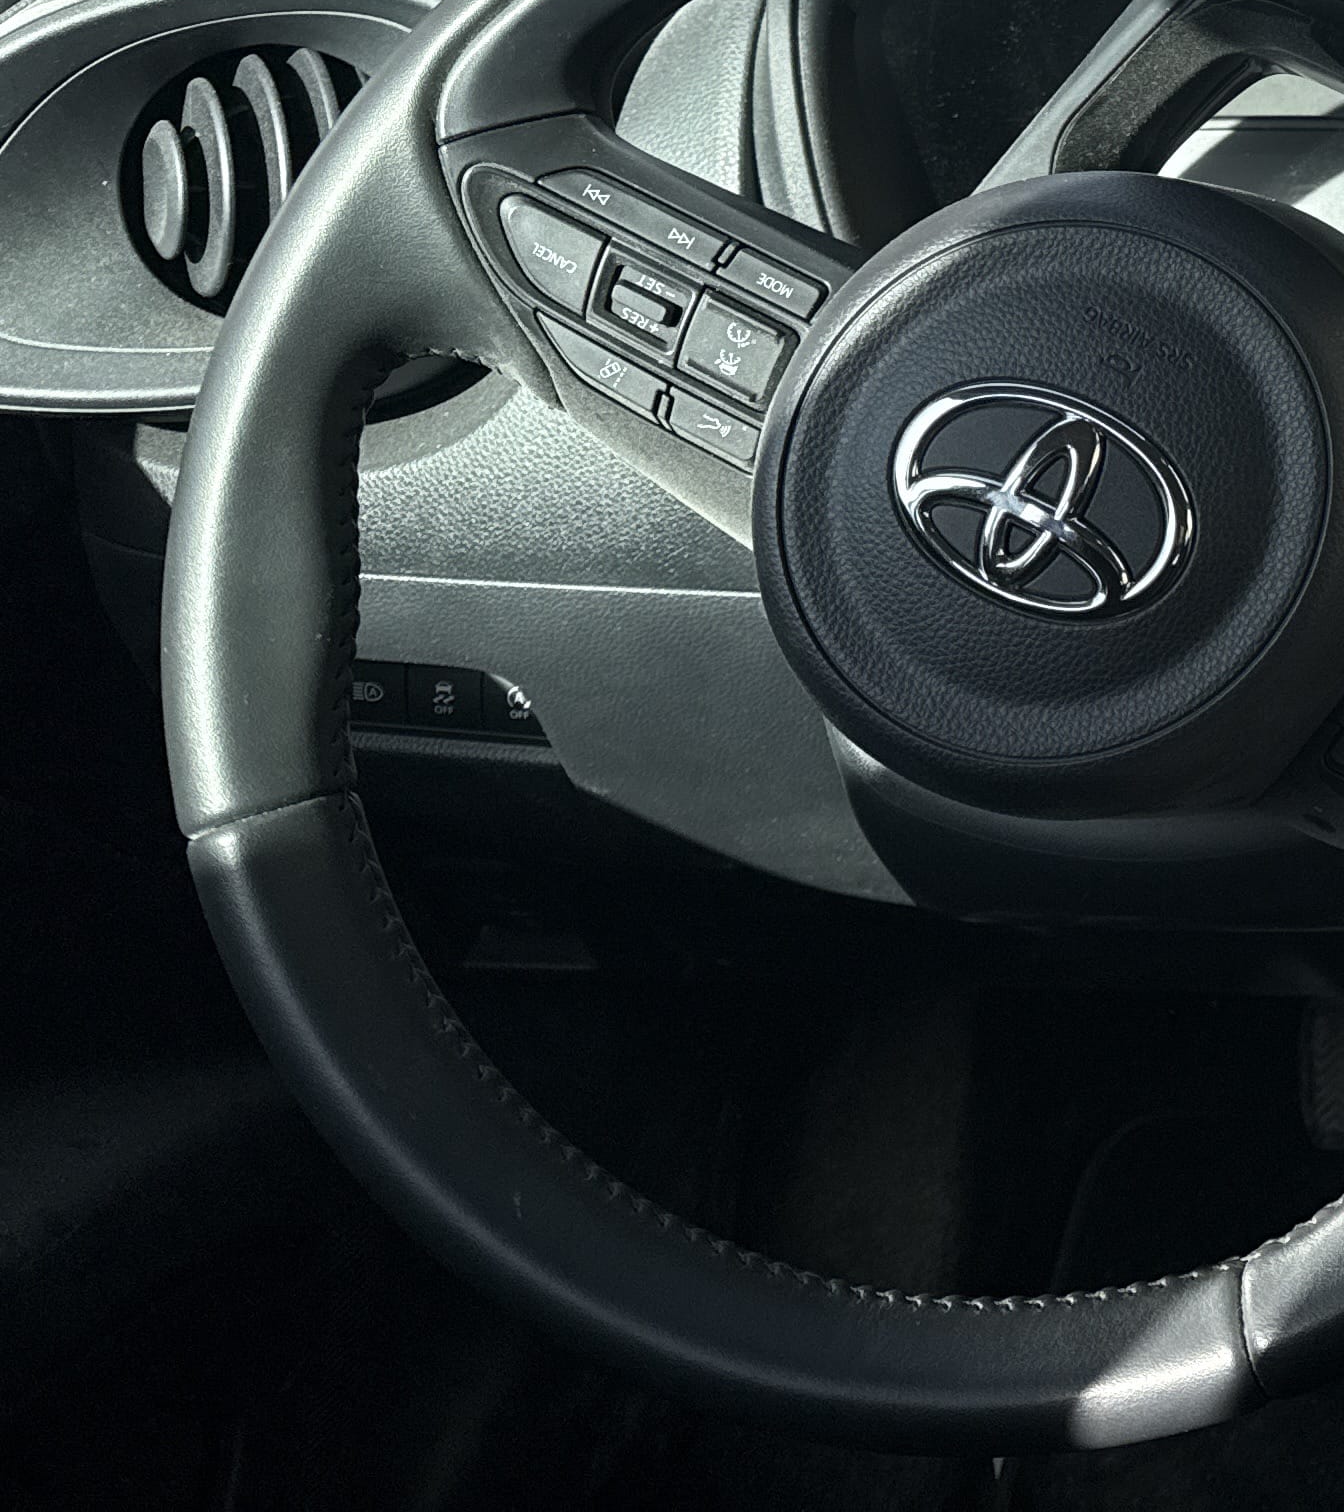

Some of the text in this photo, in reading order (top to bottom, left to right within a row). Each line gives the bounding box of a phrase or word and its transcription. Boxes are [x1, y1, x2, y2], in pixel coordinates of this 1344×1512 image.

[531, 241, 578, 275] CANCEL
[755, 272, 795, 300] MODE
[433, 705, 454, 716] OFF
[508, 709, 530, 720] OFF
